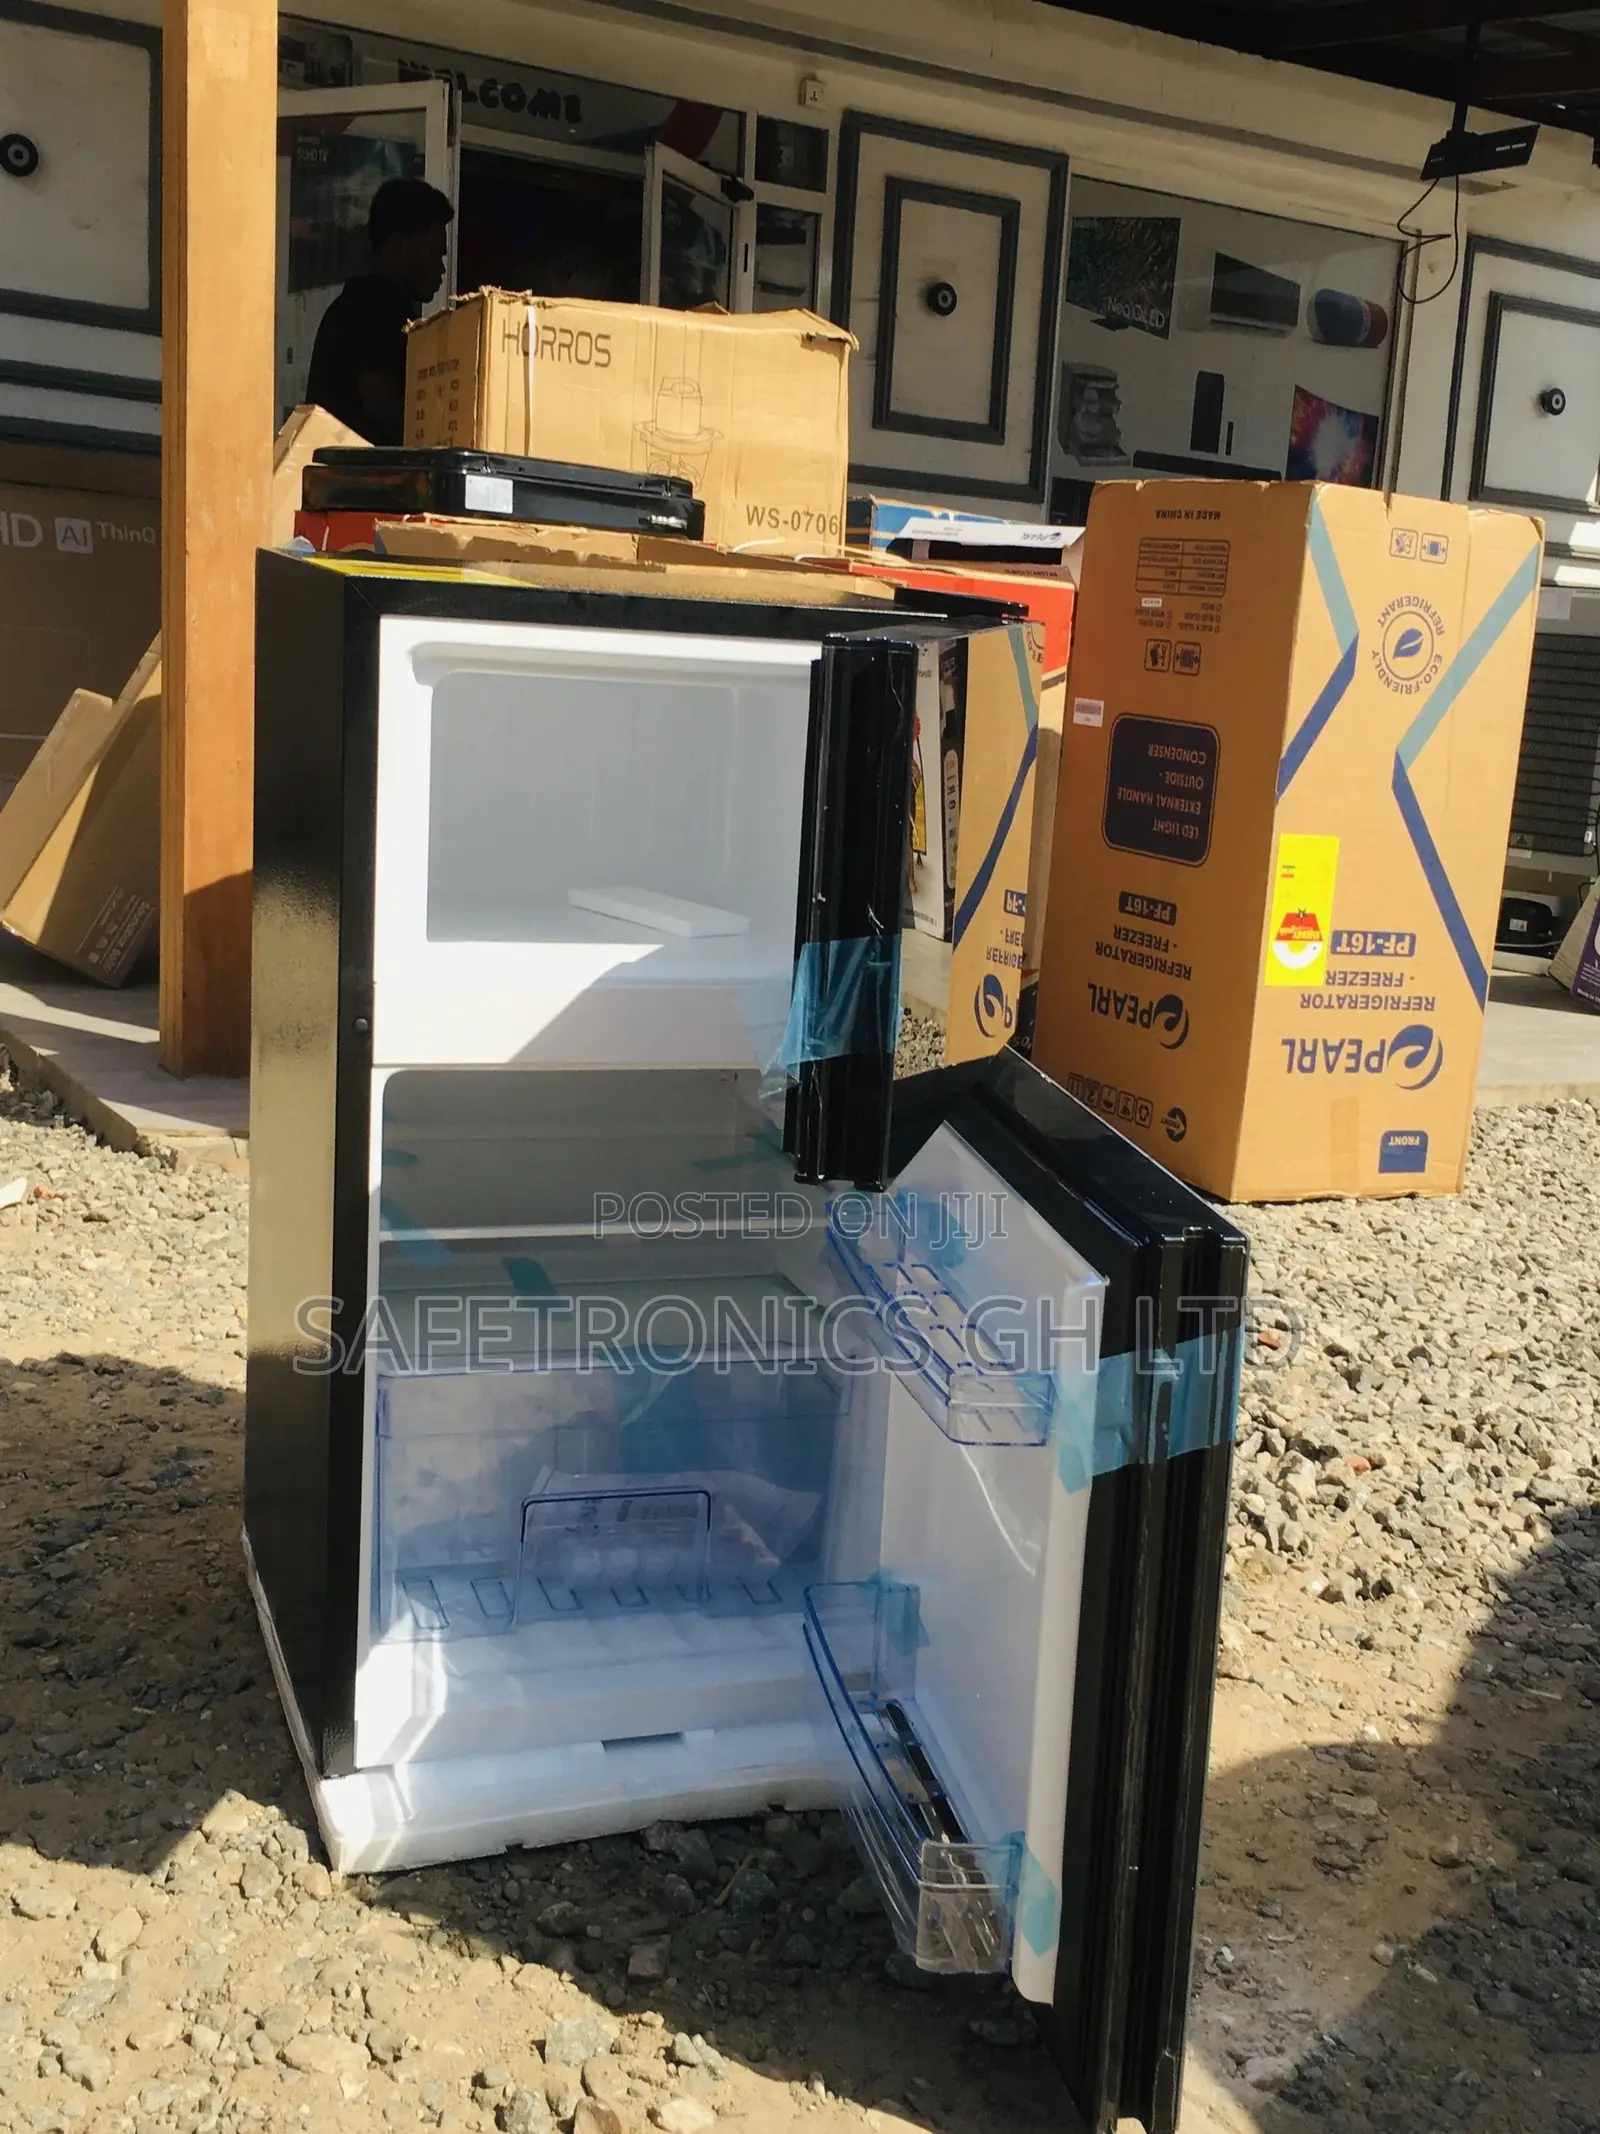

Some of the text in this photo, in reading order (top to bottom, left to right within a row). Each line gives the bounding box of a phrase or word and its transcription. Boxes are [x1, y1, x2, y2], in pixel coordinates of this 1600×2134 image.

[501, 318, 611, 368] HORROS
[746, 504, 839, 536] WS-0706
[1155, 509, 1222, 521] MADE IN CHINA
[1375, 595, 1445, 636] REFRIGERANT
[1371, 649, 1443, 695] ECO-FRIENDLY
[1147, 743, 1207, 765] CONDENSER
[1164, 771, 1204, 791] OUTSIDE
[1116, 786, 1202, 815] EXTERNAL HANDLE
[1151, 818, 1200, 840] LED LIGHT
[1125, 895, 1171, 922] PF-16T
[1112, 924, 1170, 954] FREEZER
[1336, 932, 1411, 955] PF-16T
[1095, 940, 1192, 981] REFRIGERATOR
[1325, 970, 1405, 989] FREEZER
[1087, 982, 1154, 1030] PEARL
[1299, 993, 1436, 1012] REFRIGERATOR
[1281, 1038, 1387, 1074] PEARL
[1388, 1135, 1420, 1147] FRONT
